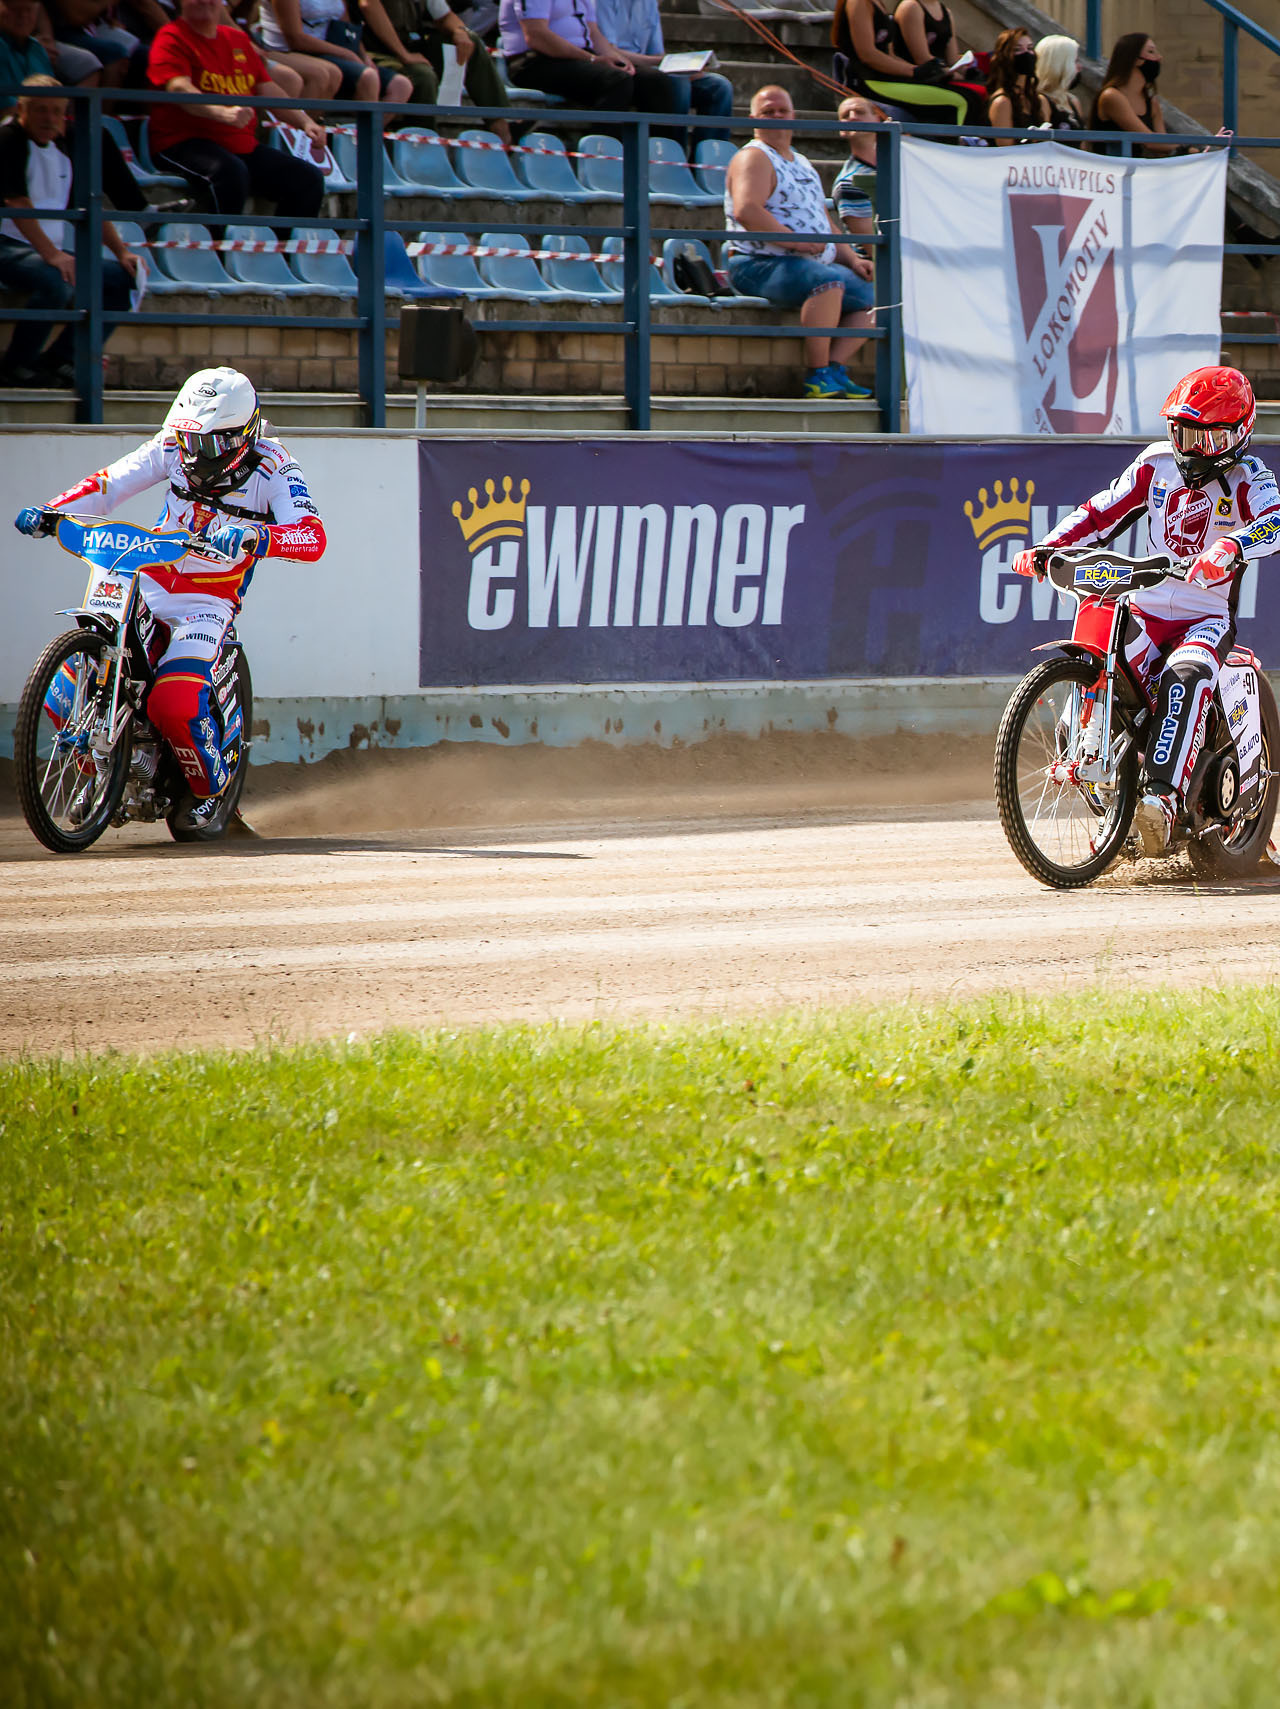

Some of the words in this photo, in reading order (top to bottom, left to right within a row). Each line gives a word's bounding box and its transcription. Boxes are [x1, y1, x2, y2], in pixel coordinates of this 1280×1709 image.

[1007, 166, 1116, 194] DAUGAVPILS
[1032, 209, 1109, 378] LOKOMOTIV
[1167, 499, 1208, 525] LOKOMOTIV
[82, 530, 158, 554] HYABAK
[1250, 520, 1280, 543] REALL
[281, 545, 302, 553] better
[1084, 569, 1121, 580] REALL
[1154, 717, 1179, 765] AUTO
